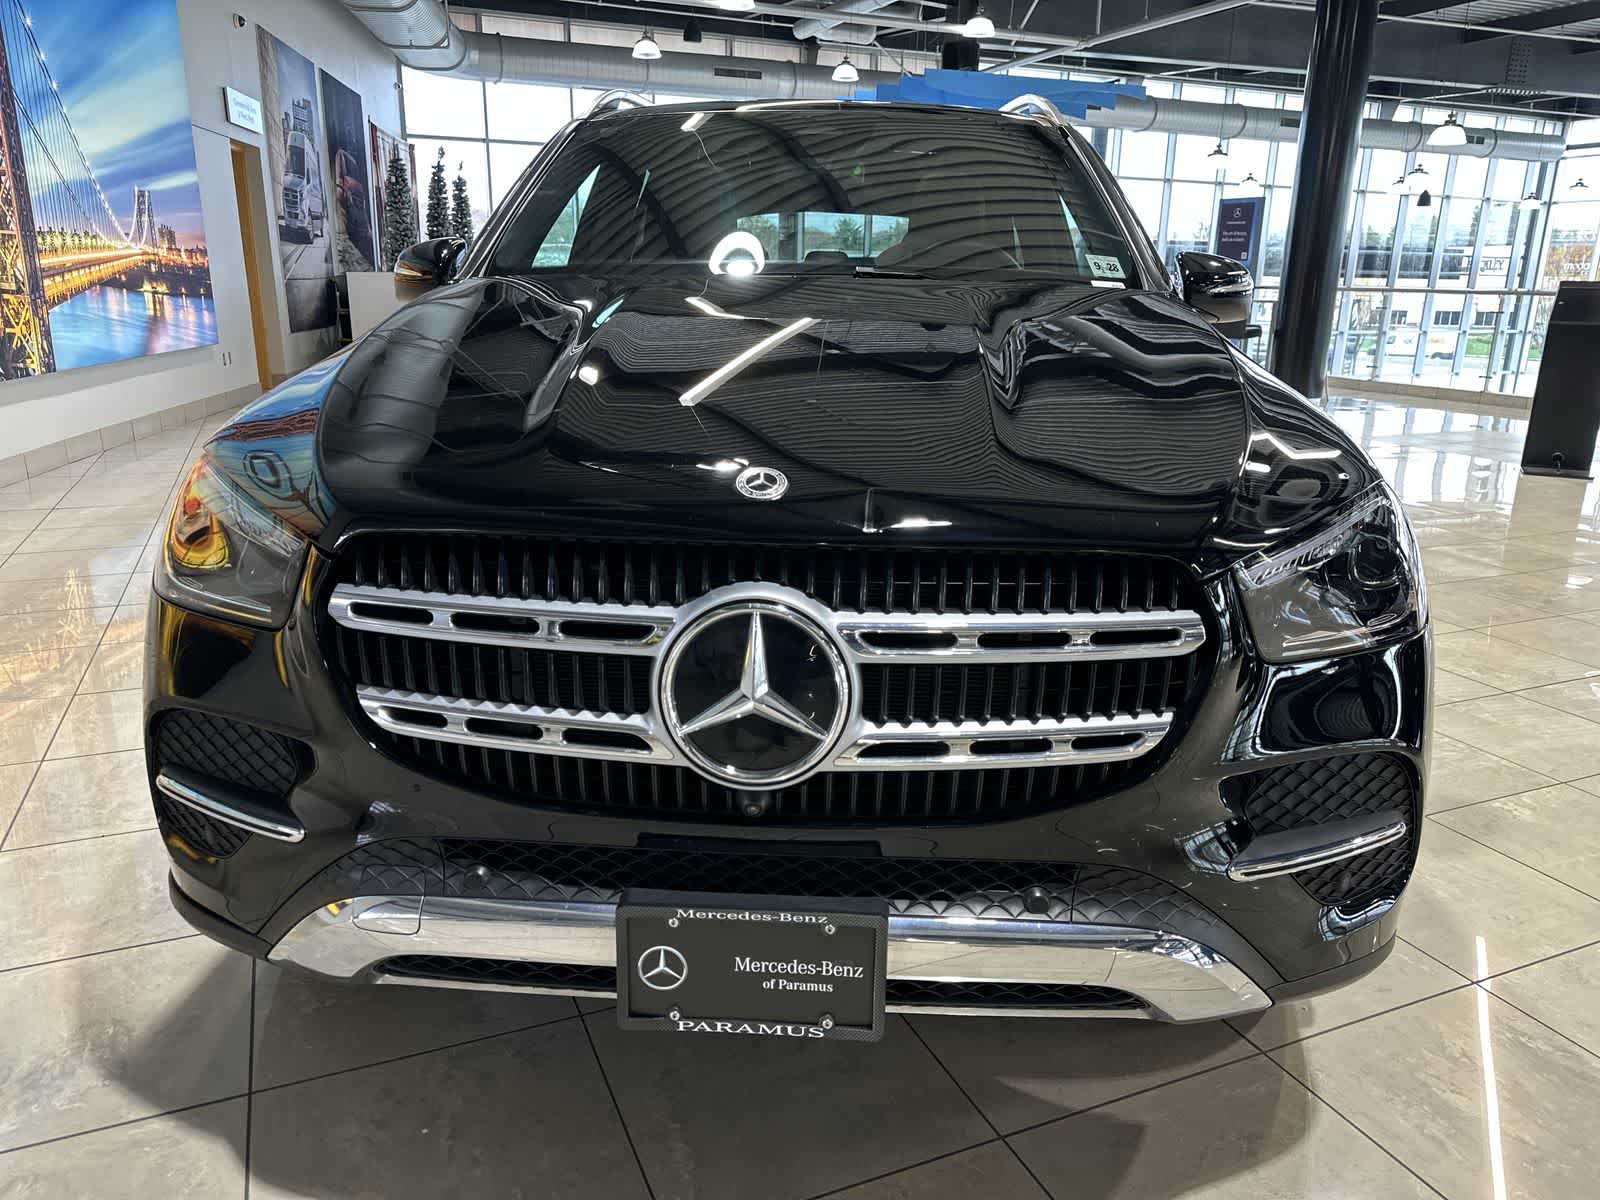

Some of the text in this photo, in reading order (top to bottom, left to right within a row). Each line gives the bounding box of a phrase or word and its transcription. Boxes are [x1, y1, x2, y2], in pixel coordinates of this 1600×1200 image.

[1106, 262, 1120, 272] 28
[676, 909, 828, 924] Mercedes-Benz
[734, 956, 864, 978] Mercedes-Benz
[762, 979, 834, 992] of Paramus
[676, 1020, 825, 1038] PARAMUS
